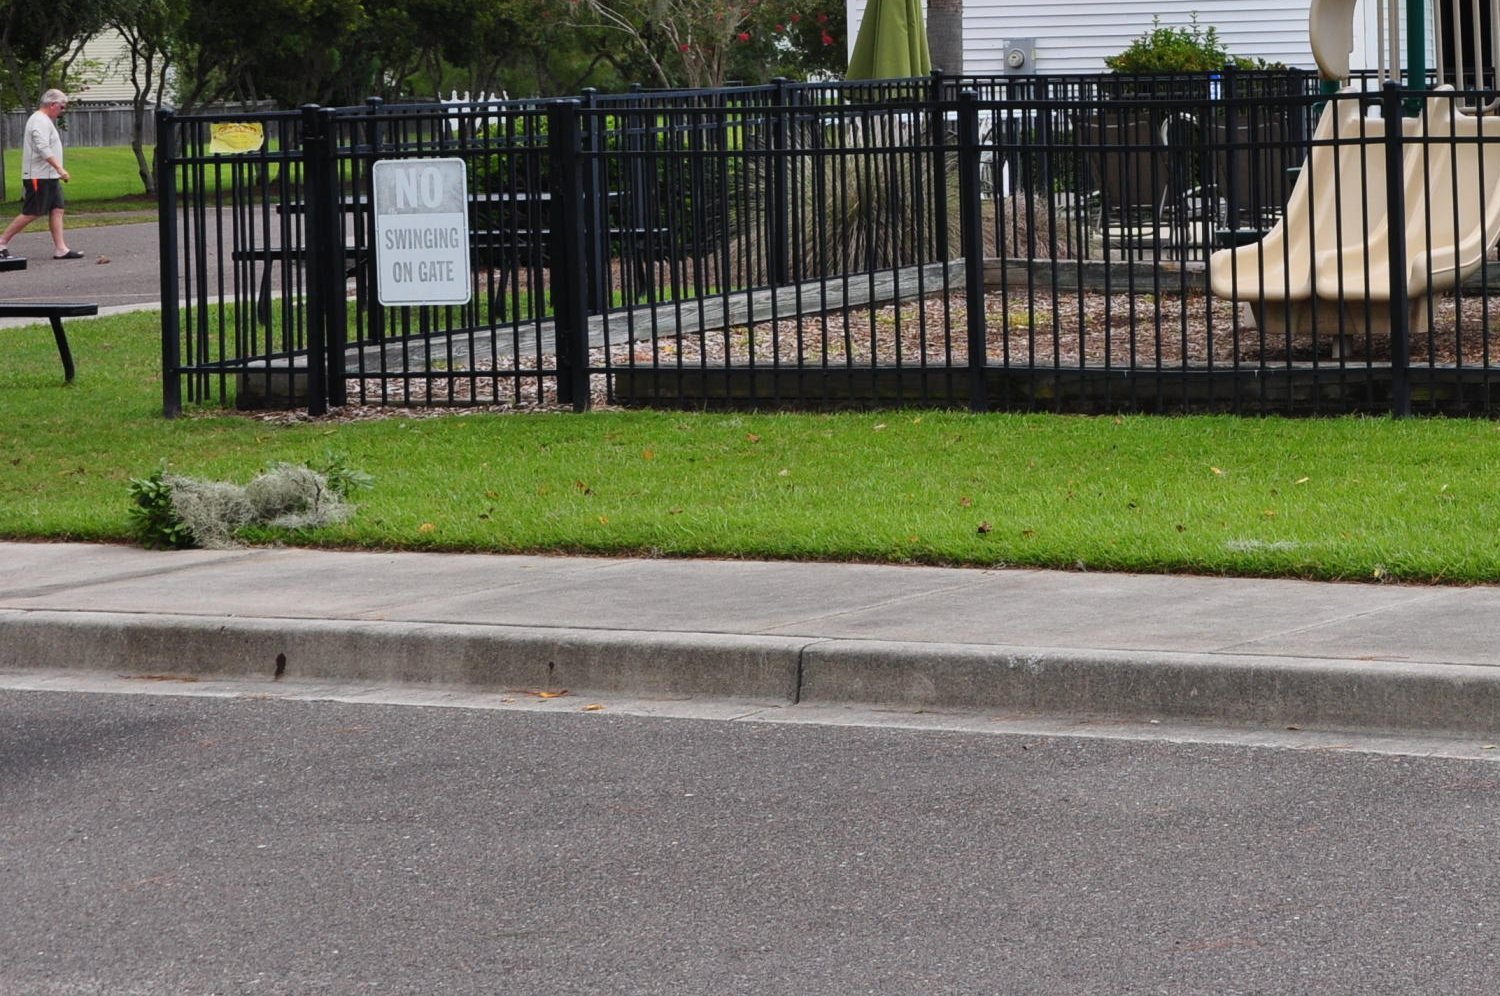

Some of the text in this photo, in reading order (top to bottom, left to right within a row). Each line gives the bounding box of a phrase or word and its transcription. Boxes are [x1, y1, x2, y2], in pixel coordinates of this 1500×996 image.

[395, 167, 443, 209] NO
[385, 227, 459, 250] SWINGING
[393, 260, 454, 283] ON GATE
